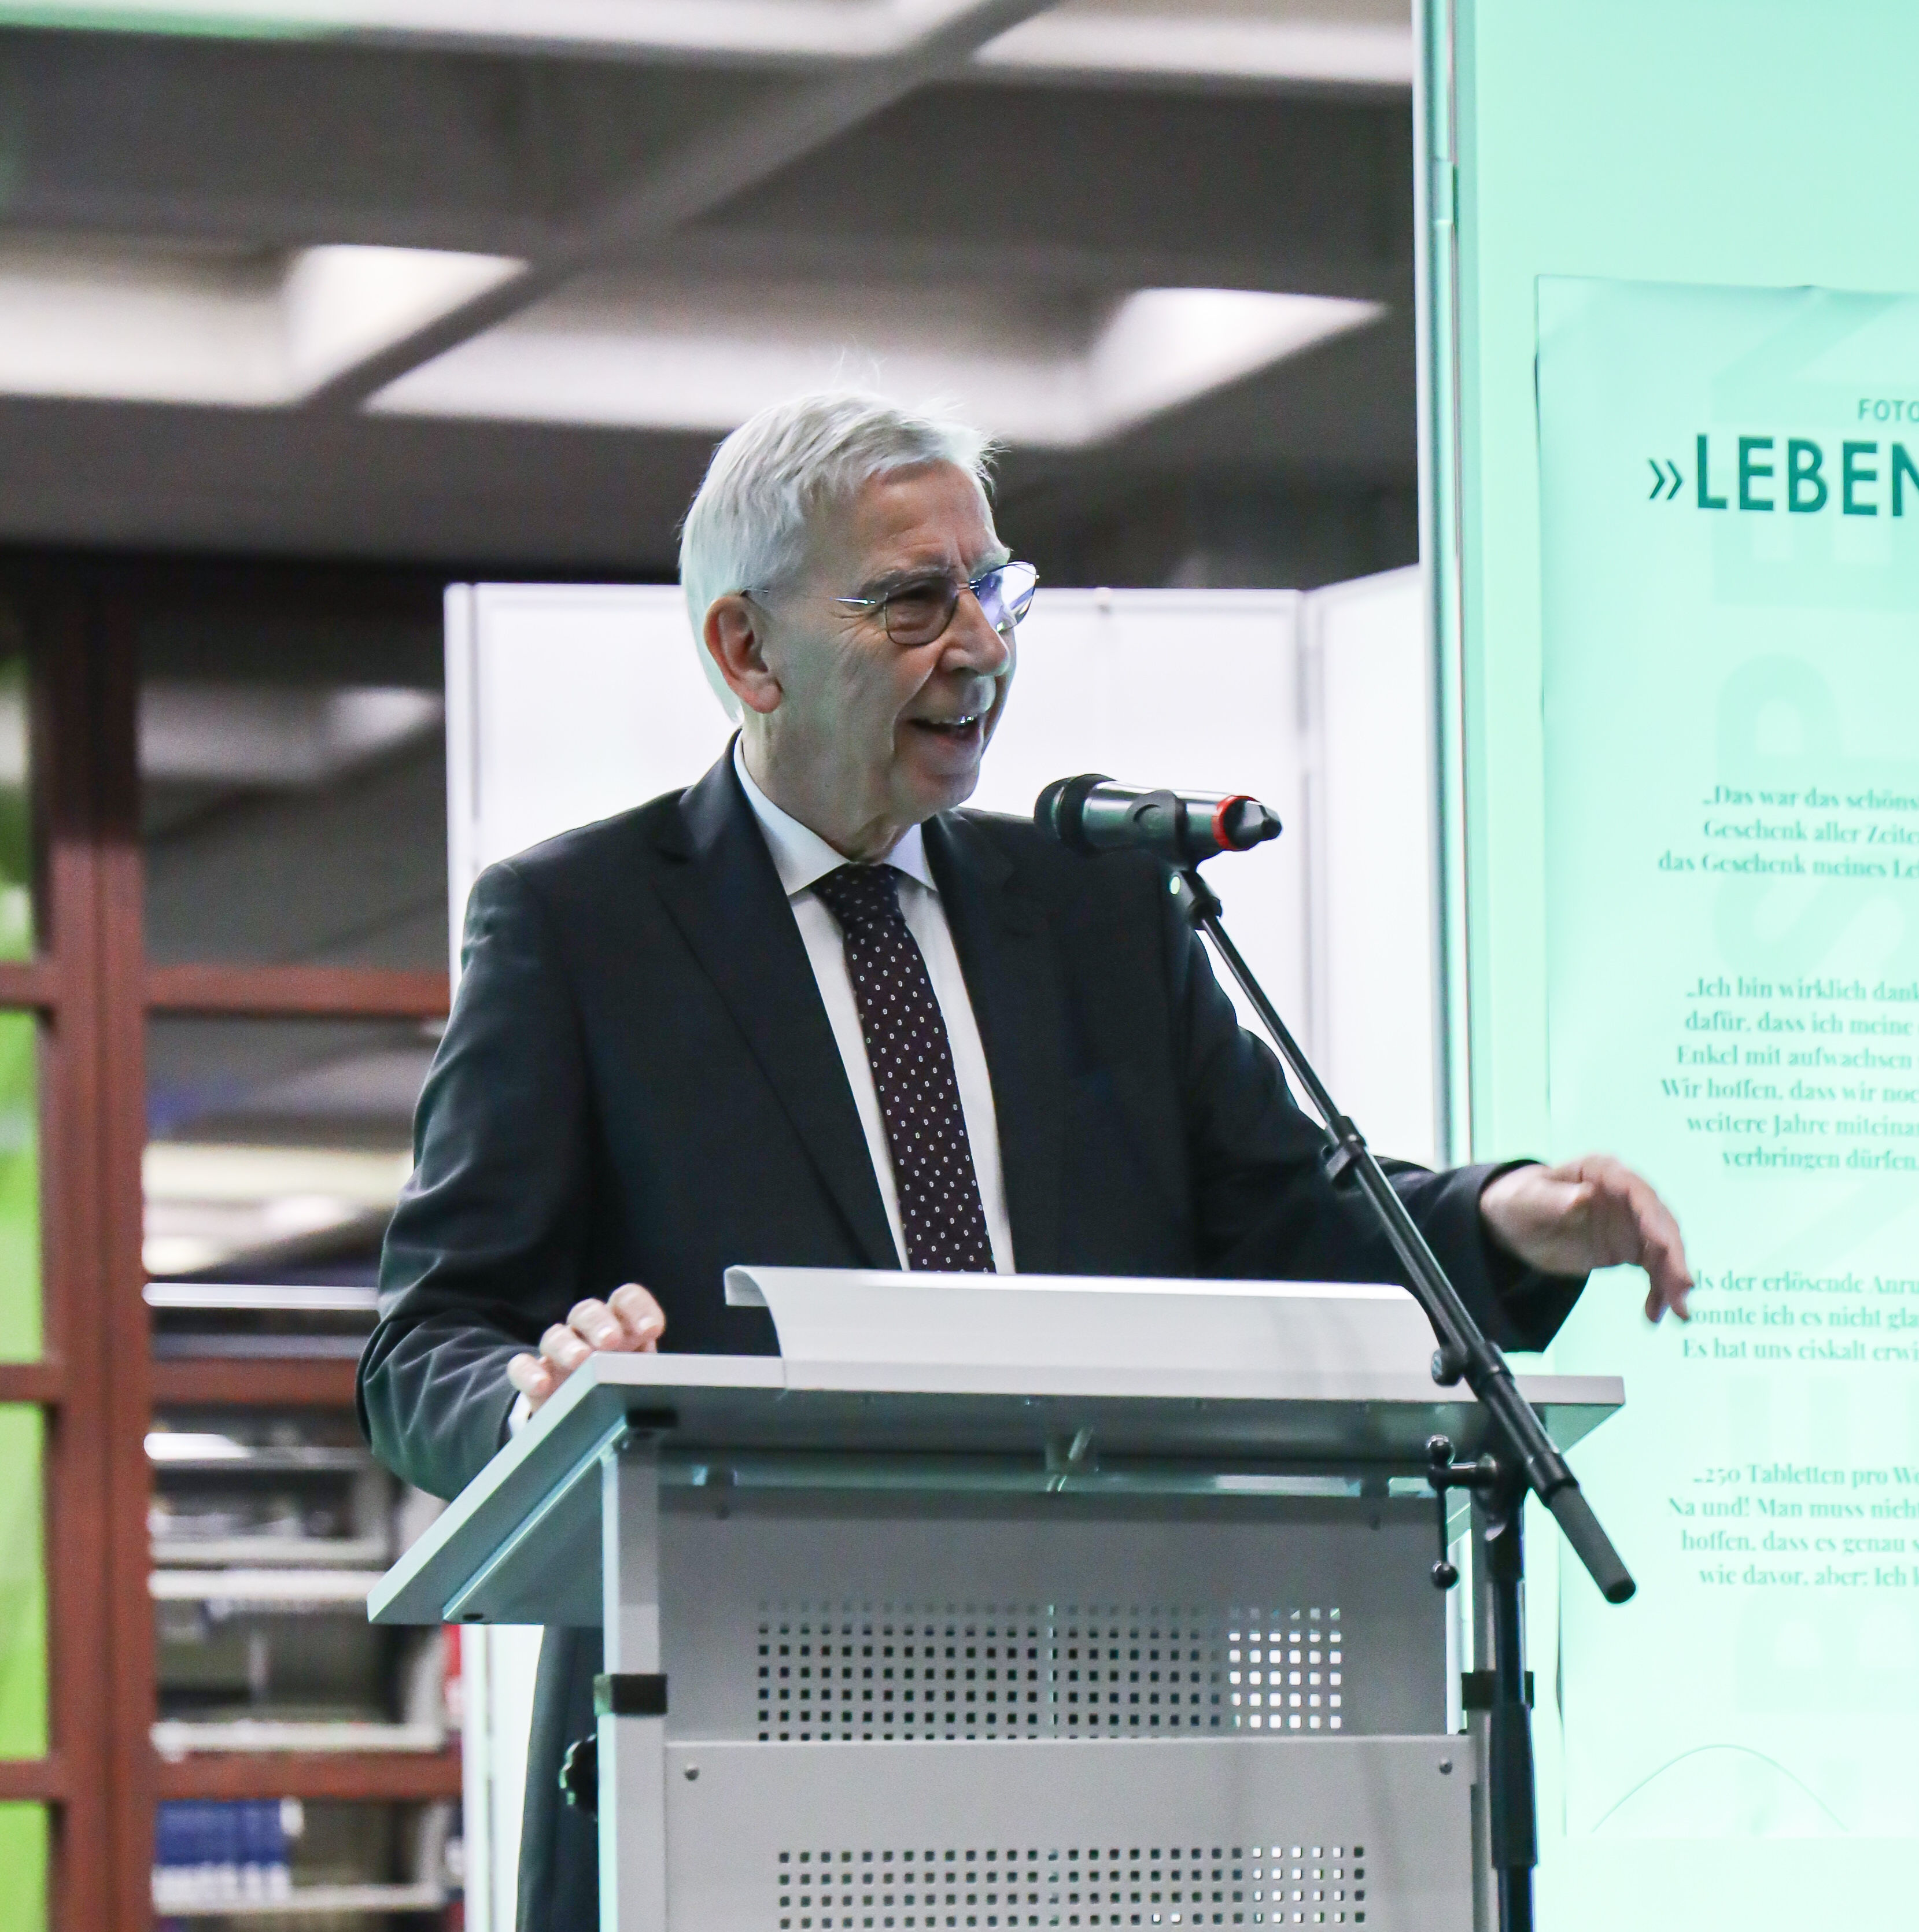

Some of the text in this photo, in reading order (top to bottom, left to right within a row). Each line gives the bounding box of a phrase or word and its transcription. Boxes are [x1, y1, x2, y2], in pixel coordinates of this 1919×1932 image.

[1857, 398, 1919, 422] FOTO
[1759, 790, 1798, 806] war
[1805, 787, 1840, 806] das
[1703, 819, 1808, 840] Geschenk
[1814, 821, 1861, 842] aller
[1659, 850, 1695, 871] das
[1702, 852, 1805, 873] Geschenk
[1814, 855, 1887, 878] meines
[1738, 976, 1773, 997] bin
[1779, 978, 1866, 1000] wirklich
[1758, 1012, 1804, 1032] dass
[1811, 1013, 1843, 1033] ich
[1850, 1014, 1913, 1035] meine
[1678, 1044, 1911, 1069] Enkel mit aufwachsen
[1661, 1078, 1701, 1098] Wir
[1791, 1079, 1836, 1100] dass
[1842, 1082, 1877, 1101] wir
[1687, 1113, 1919, 1137] weitere Jahre miteina
[1723, 1146, 1840, 1170] verbringen
[1697, 1270, 1713, 1290] ls
[1722, 1271, 1755, 1291] der
[1763, 1271, 1862, 1293] erlösende
[1689, 1307, 1756, 1325] onnte
[1764, 1305, 1793, 1325] ich
[1801, 1309, 1822, 1326] es
[1829, 1306, 1880, 1327] nicht
[1683, 1338, 1707, 1357] Es
[1715, 1338, 1747, 1358] hat
[1755, 1343, 1792, 1359] uns
[1799, 1339, 1865, 1361] eiskalt
[1748, 1464, 1845, 1485] Tabletten
[1852, 1468, 1888, 1488] pro
[1669, 1497, 1695, 1517] Na
[1758, 1499, 1802, 1517] Man
[1810, 1502, 1865, 1517] muss
[1763, 1530, 1809, 1551] dass
[1816, 1537, 1836, 1551] es
[1843, 1538, 1905, 1554] genau
[1700, 1564, 1736, 1584] wie
[1874, 1566, 1906, 1587] Ich
